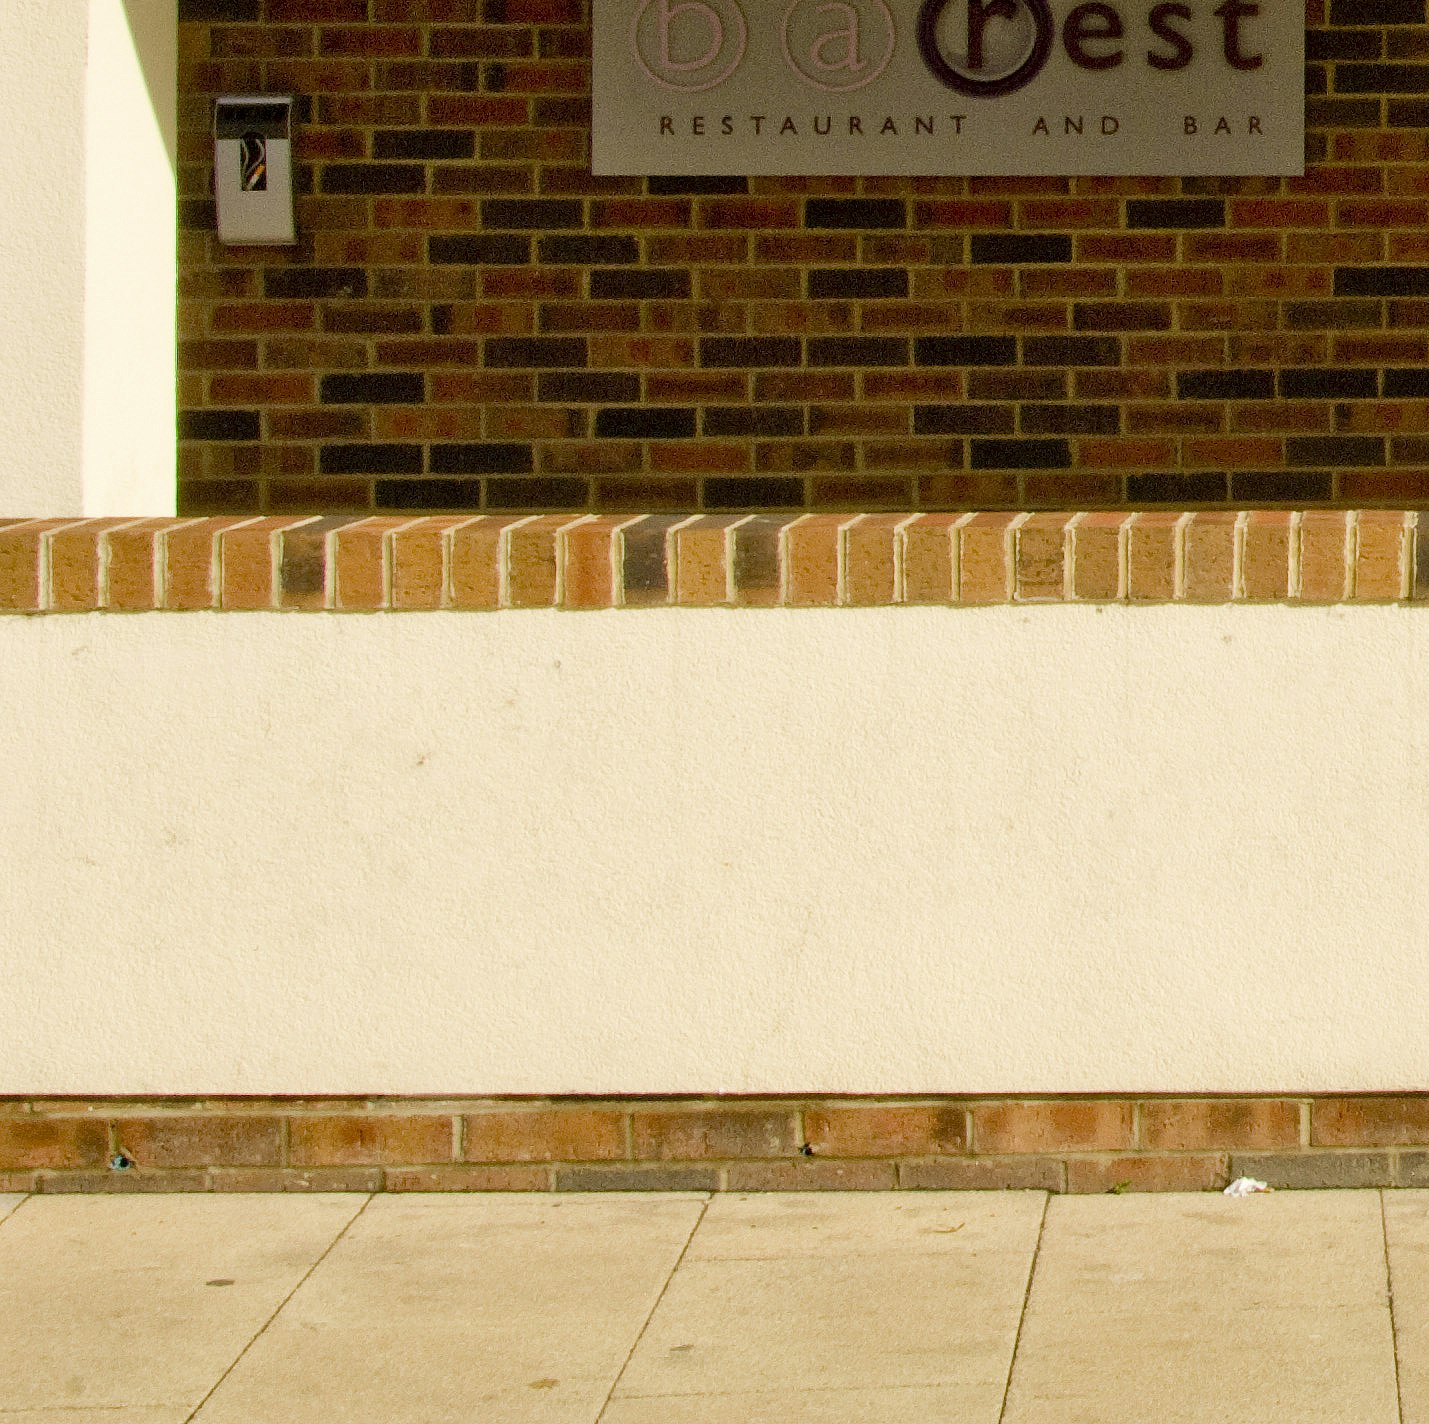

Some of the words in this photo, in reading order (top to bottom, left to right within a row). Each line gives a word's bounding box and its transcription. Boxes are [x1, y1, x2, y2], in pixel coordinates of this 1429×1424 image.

[659, 116, 968, 136] RESTAURANT
[1032, 116, 1120, 136] AND
[1184, 116, 1264, 136] BAR
